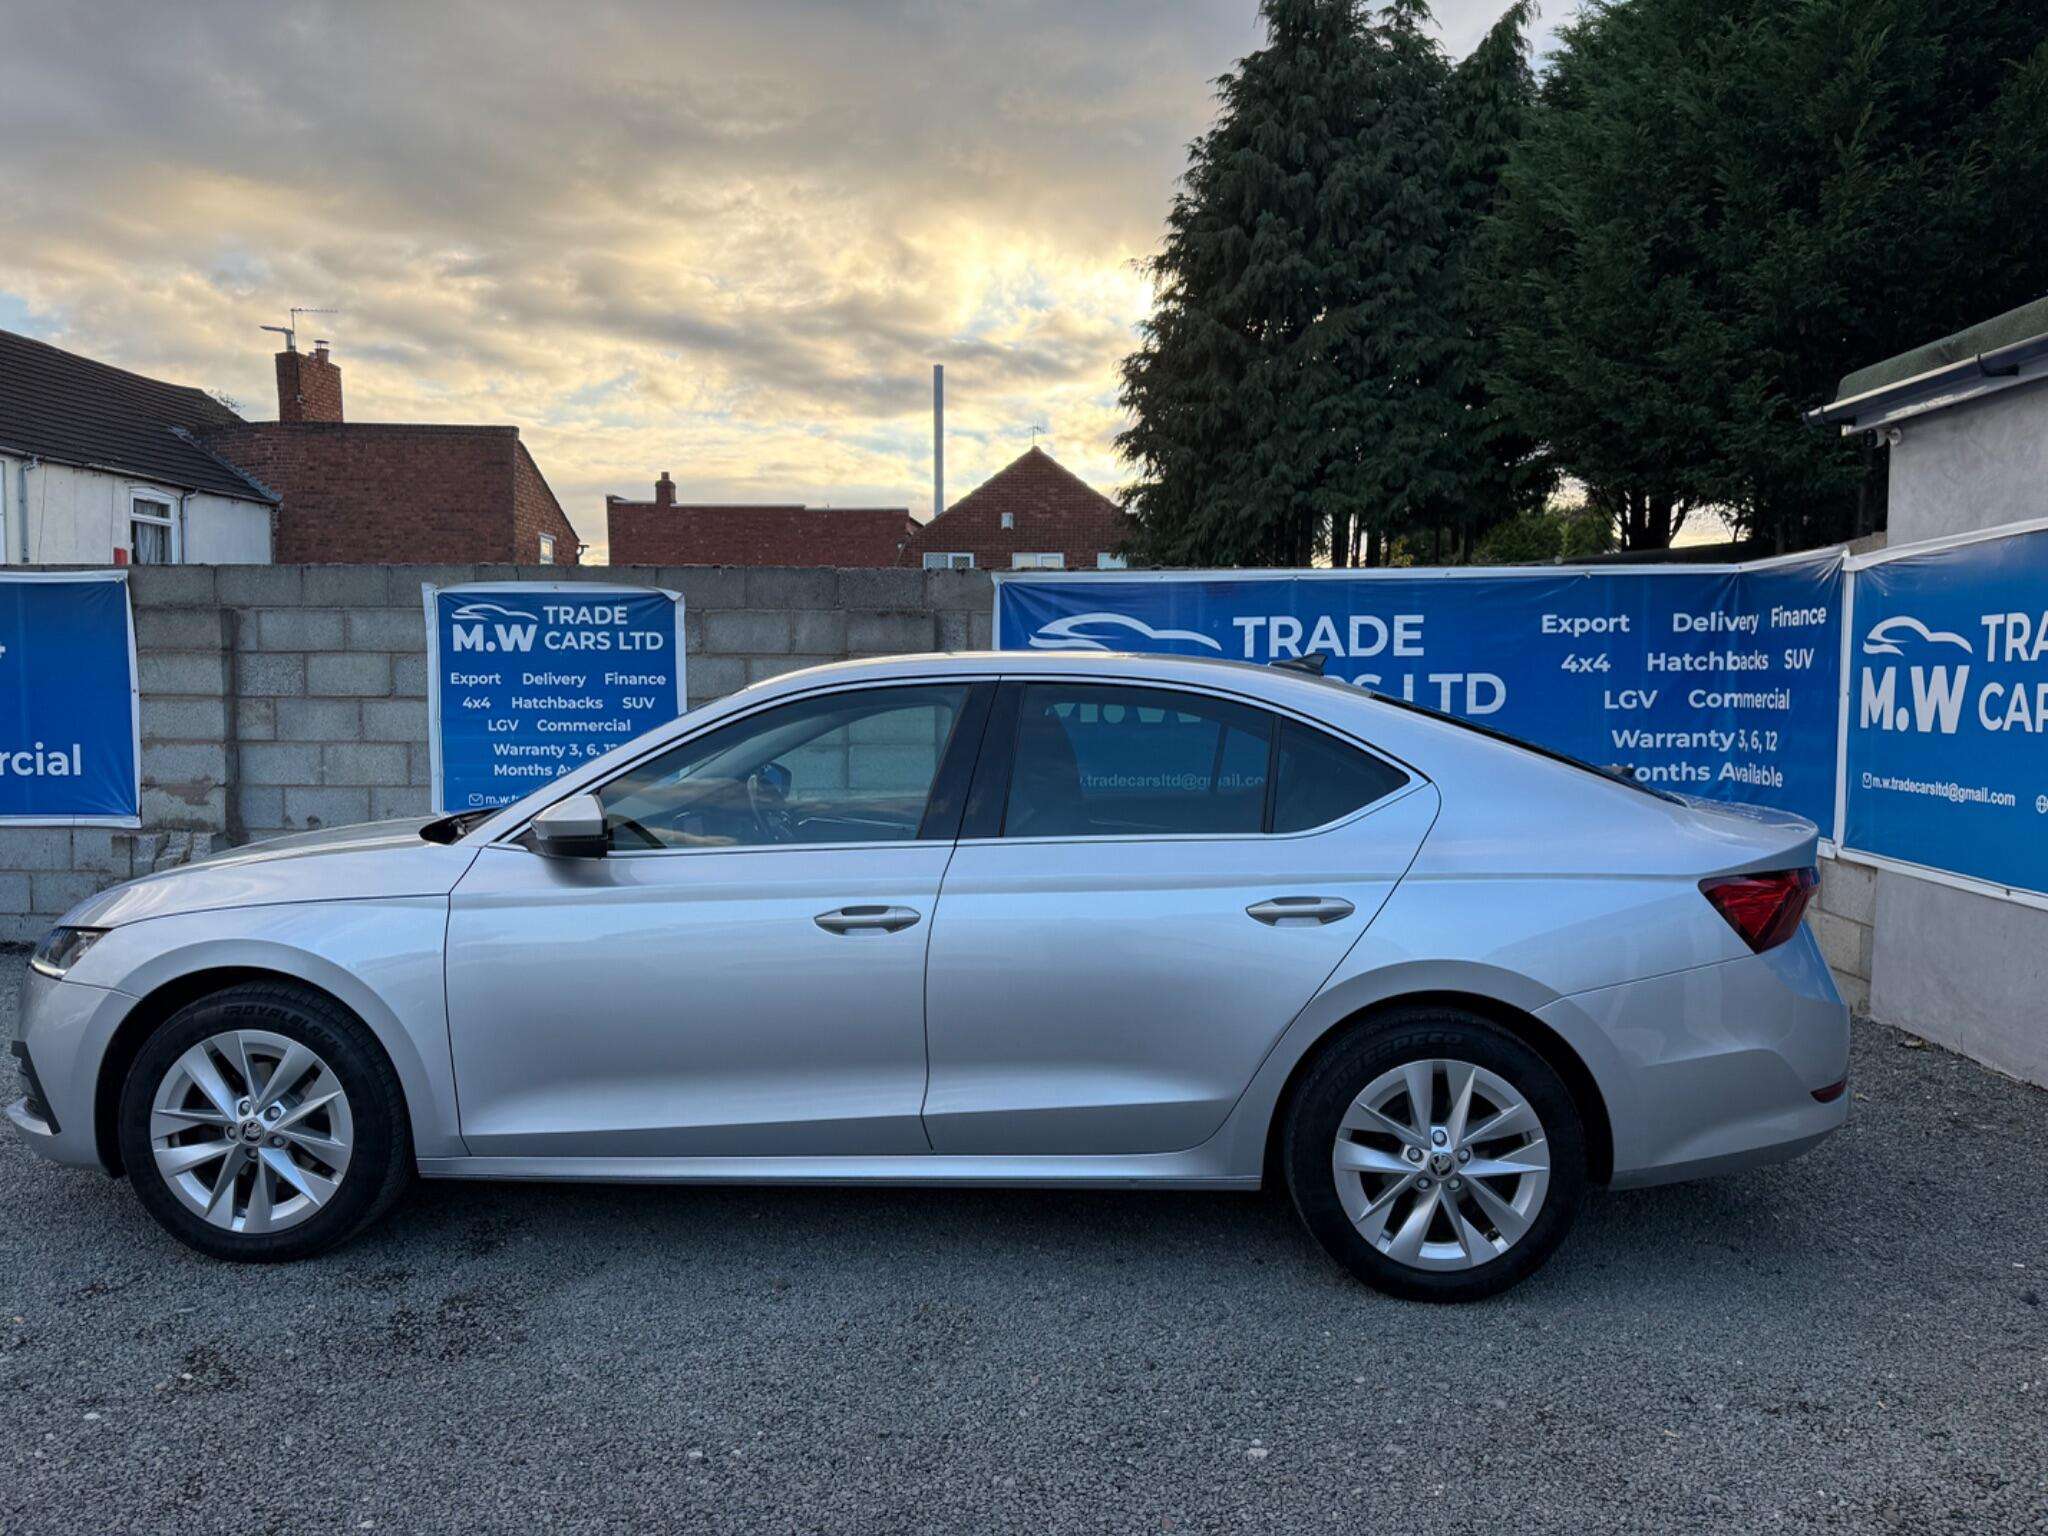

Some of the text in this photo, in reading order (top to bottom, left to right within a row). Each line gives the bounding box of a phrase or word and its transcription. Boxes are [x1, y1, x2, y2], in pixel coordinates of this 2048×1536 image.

[543, 606, 628, 625] TRADE
[1541, 606, 1827, 637] Export Delivery Finance
[452, 624, 538, 652] M.W
[544, 631, 664, 650] CARS LTD
[1233, 614, 1425, 657] TRADE
[1561, 648, 1814, 672] 4x4 Hatchbacks SUV
[450, 672, 666, 687] Export Delivery Finance
[462, 696, 655, 709] 4x4 Hatchbacks SUV
[1604, 688, 1790, 710] LGV Commercial
[1860, 665, 1970, 734] M.W
[488, 719, 631, 732] LGV Commercial
[493, 743, 566, 757] Warranty
[1611, 729, 1778, 752] Warranty 3, 6, 12
[494, 764, 553, 777] Months
[1611, 762, 1783, 788] onths Available
[1872, 776, 2016, 807] m.w.tradecarsltd@gmail.com
